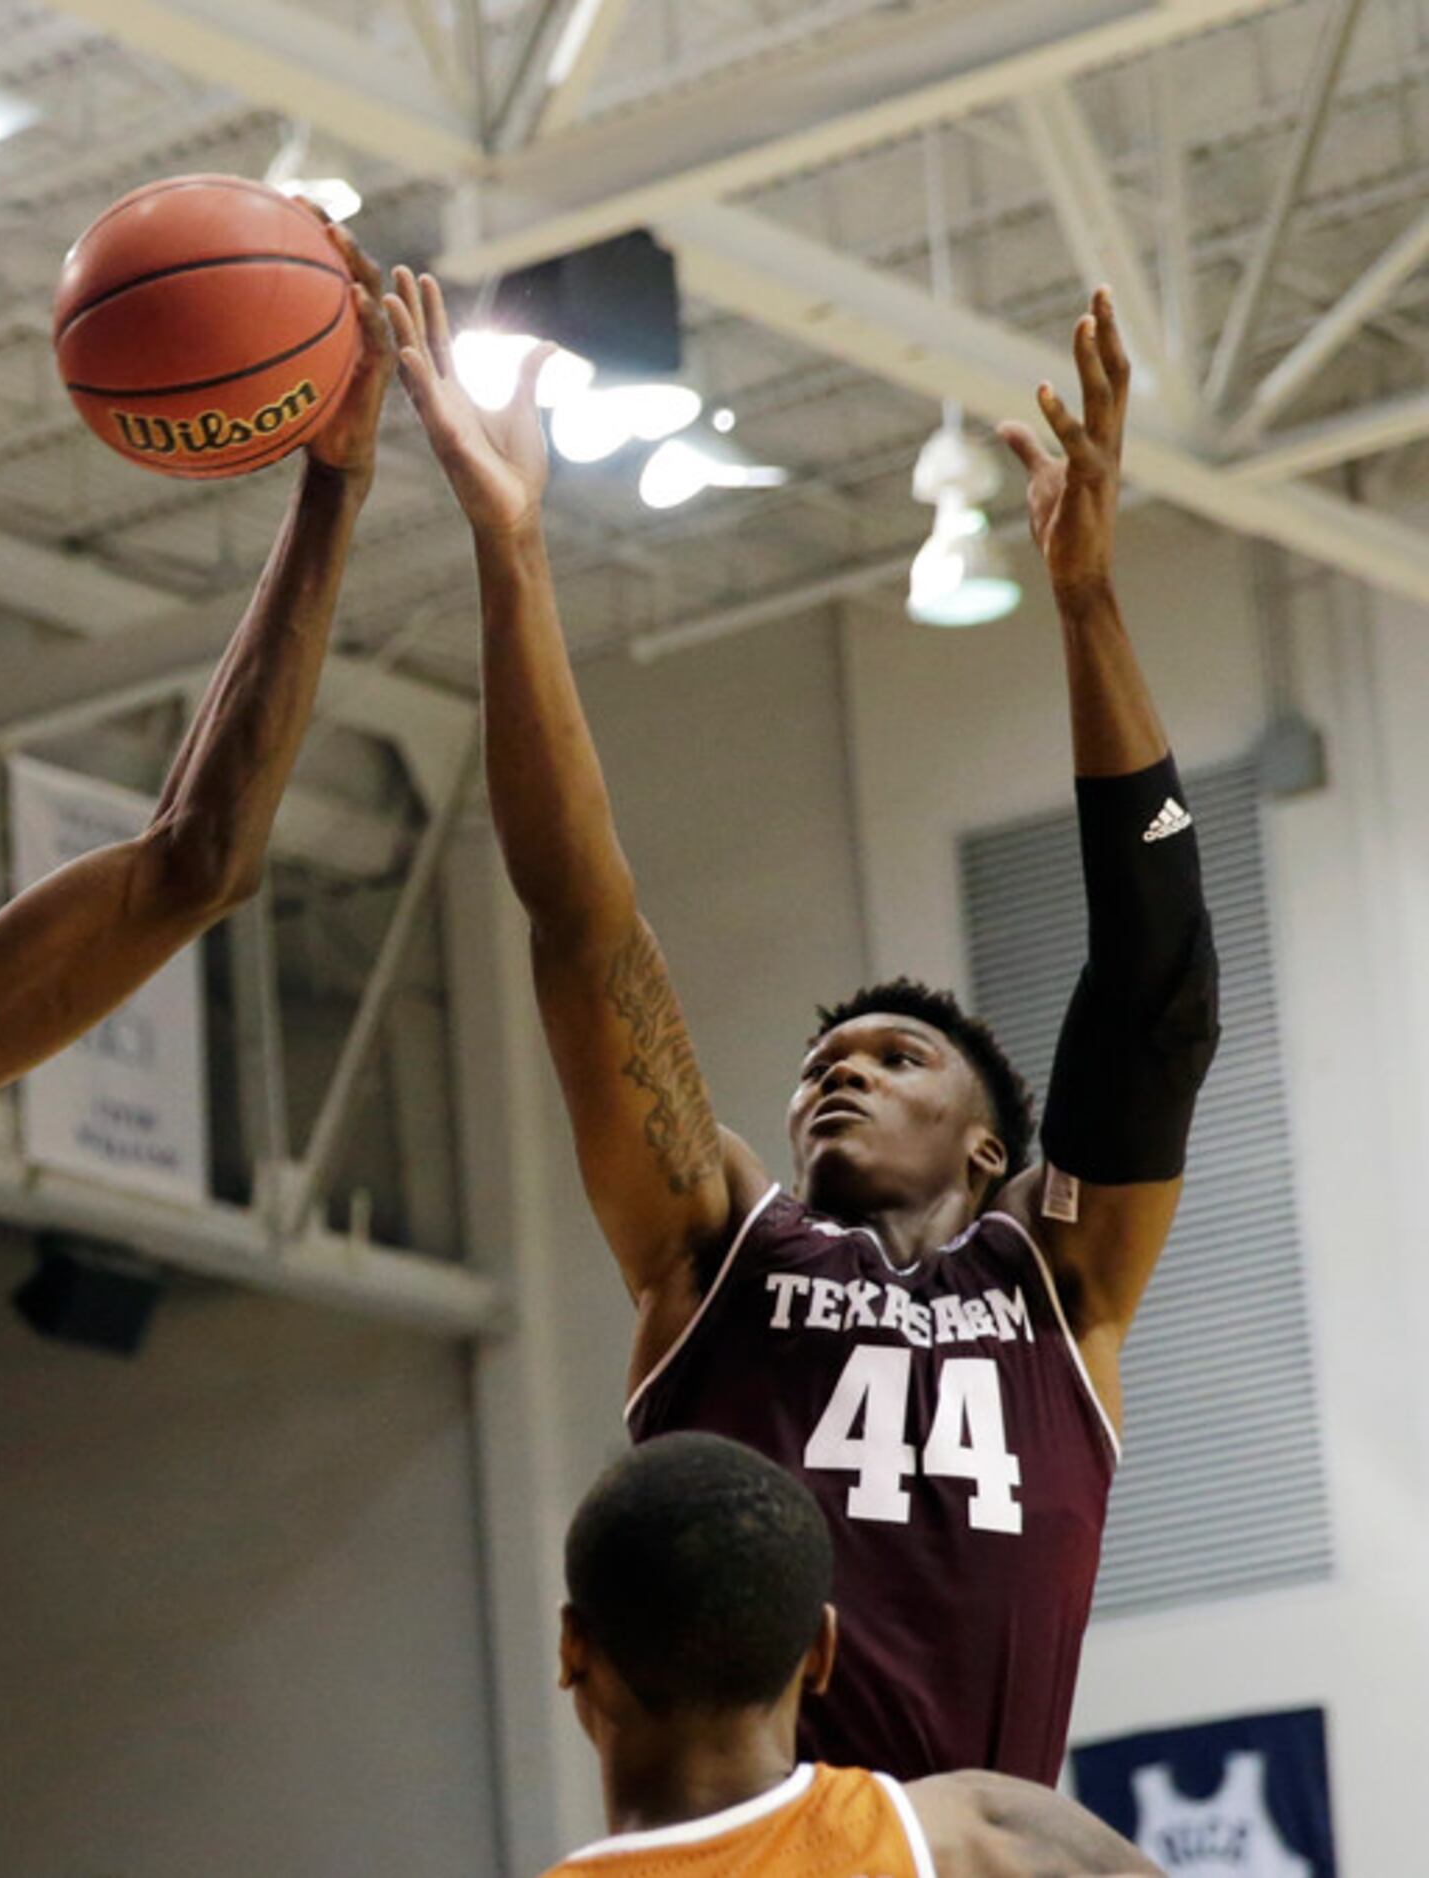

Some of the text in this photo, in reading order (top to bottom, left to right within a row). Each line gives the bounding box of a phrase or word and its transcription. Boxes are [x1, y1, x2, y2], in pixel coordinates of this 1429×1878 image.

[113, 380, 318, 453] Wilson
[766, 1274, 1035, 1347] TEXAS A&M
[803, 1345, 1023, 1534] 44
